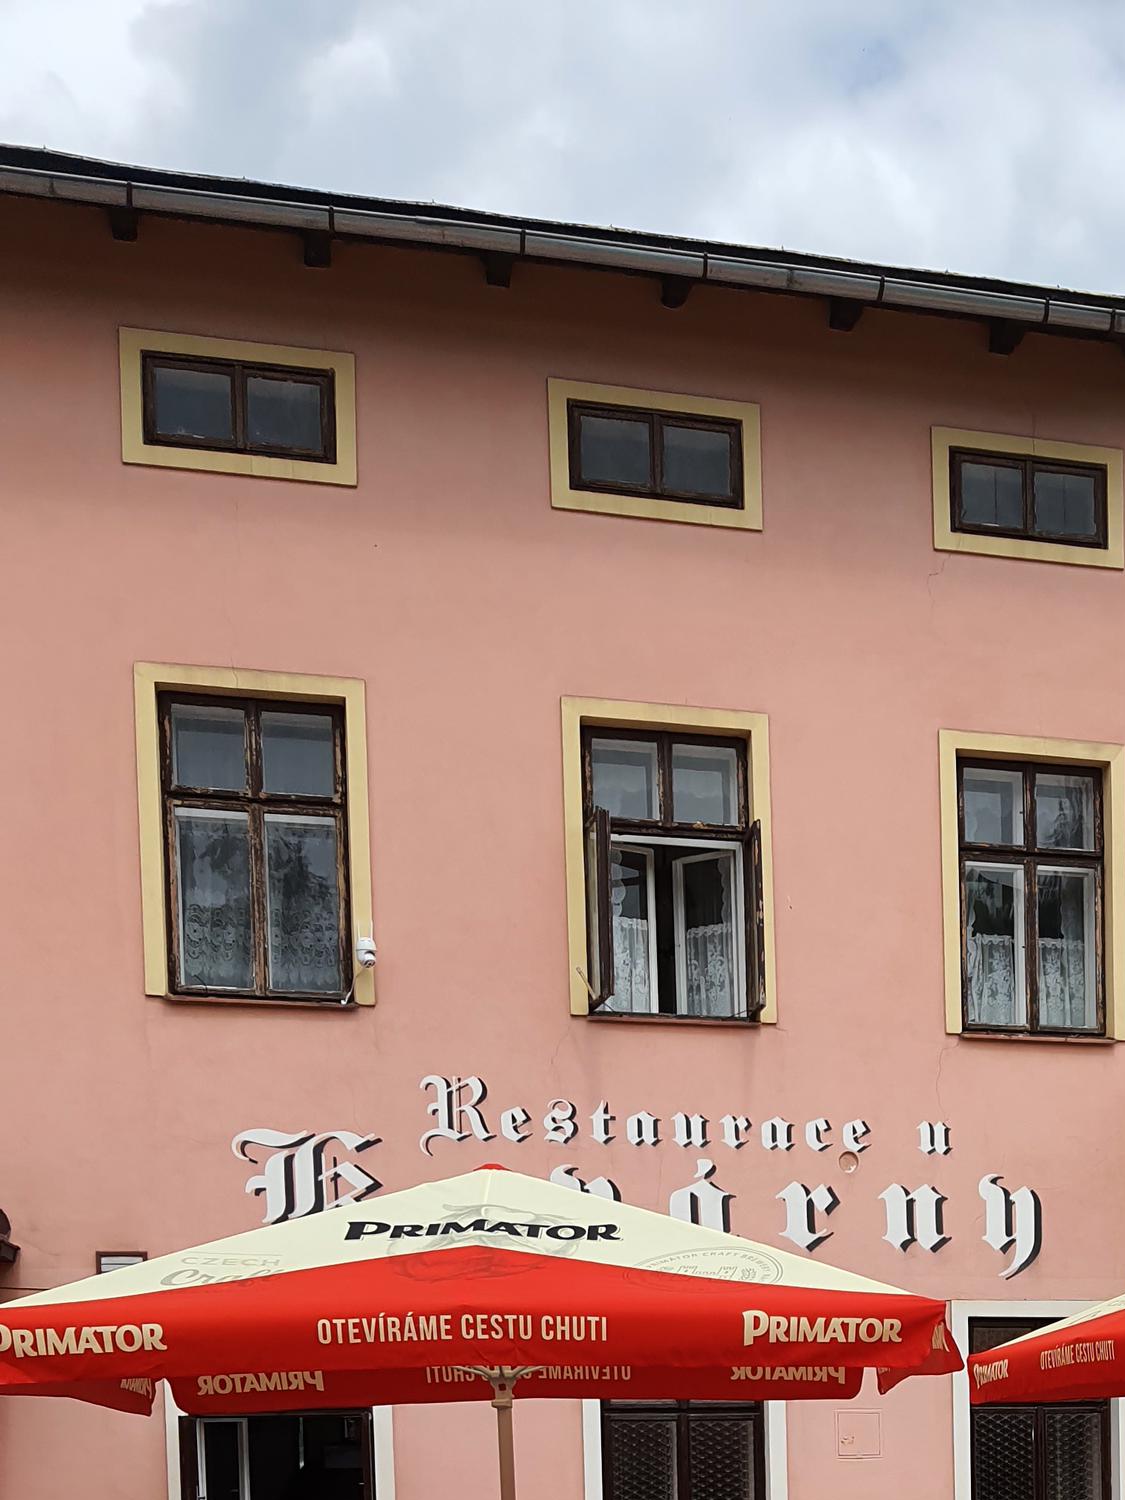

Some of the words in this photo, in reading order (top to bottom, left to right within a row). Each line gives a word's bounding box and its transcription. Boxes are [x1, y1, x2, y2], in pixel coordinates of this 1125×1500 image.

[420, 1075, 872, 1156] Restaurace
[916, 1119, 954, 1156] u
[231, 1128, 1043, 1280] Kárny
[344, 1218, 622, 1242] PRIMATOR
[317, 1312, 453, 1344] OTEVÍRÁME
[461, 1314, 532, 1340] CESTU
[541, 1316, 608, 1341] CHUTI
[742, 1310, 902, 1346] PRIMATOR
